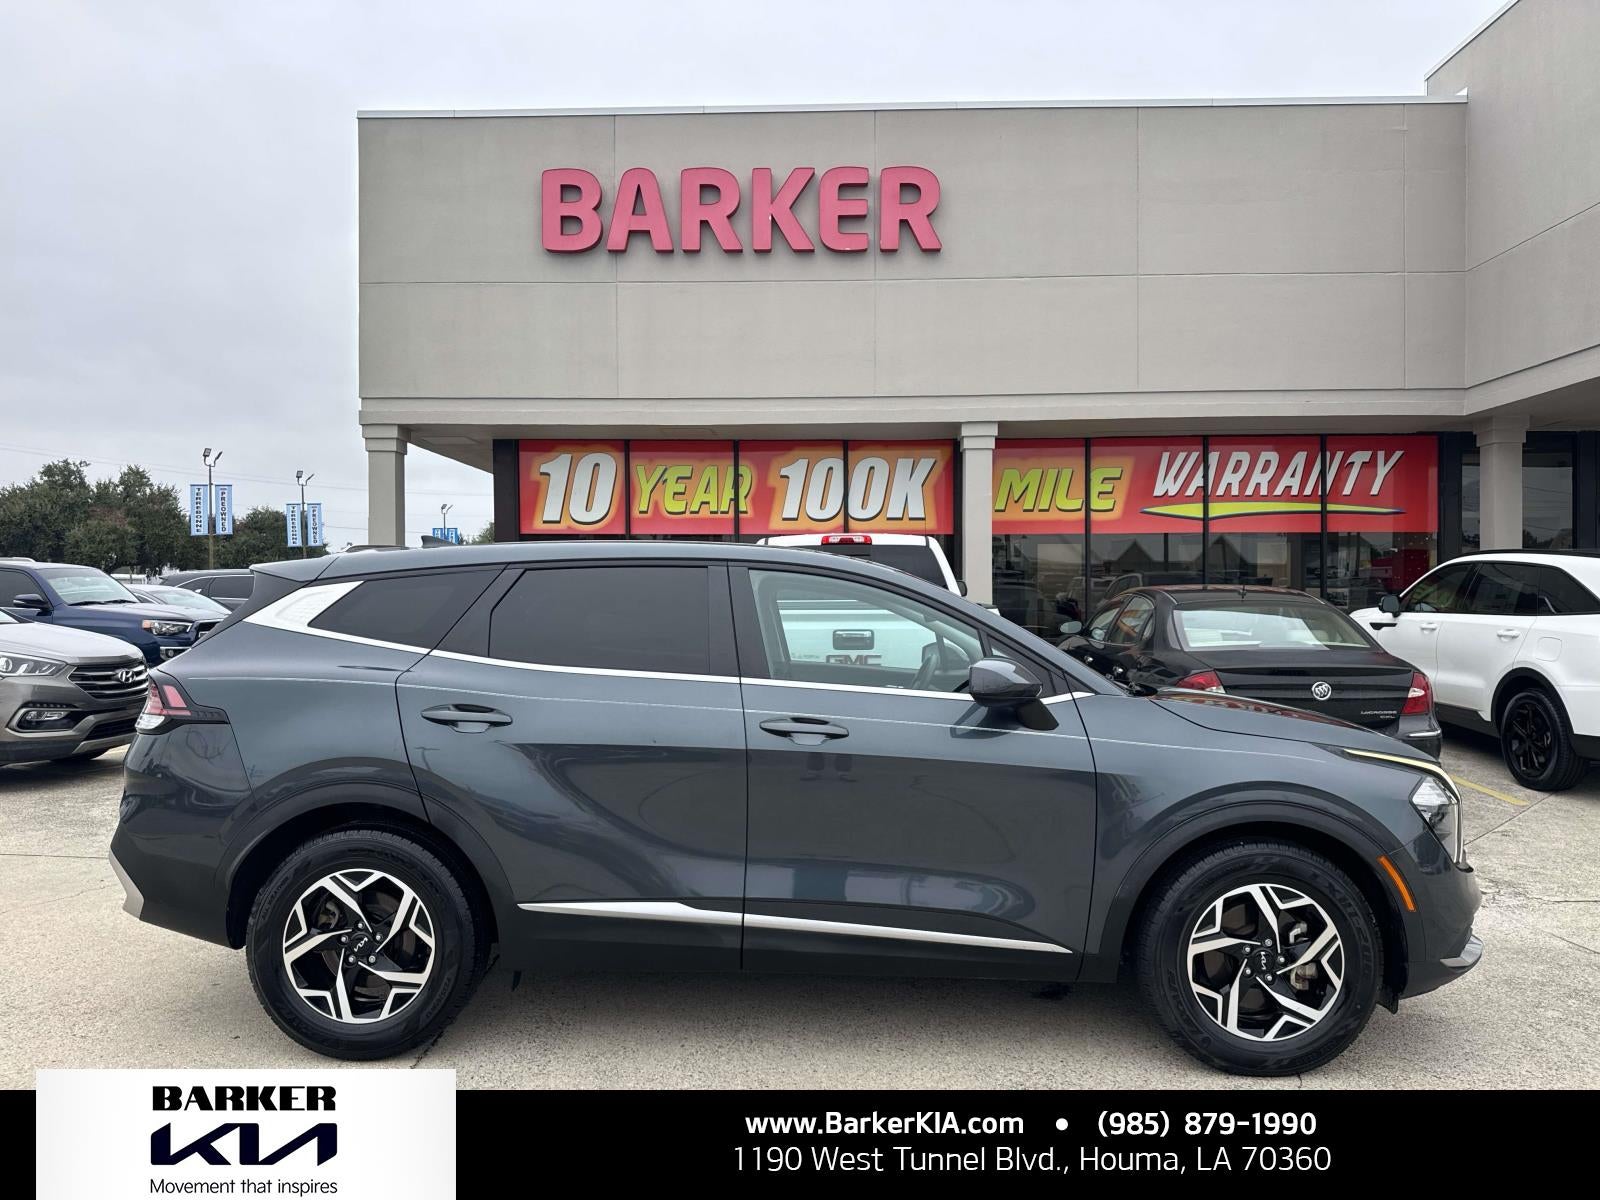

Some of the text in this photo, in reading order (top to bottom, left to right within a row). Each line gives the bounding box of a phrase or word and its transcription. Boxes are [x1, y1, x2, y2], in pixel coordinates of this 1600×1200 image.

[542, 166, 942, 252] BARKER
[195, 487, 203, 533] TERREBONNE
[539, 449, 1405, 526] 10 YEAR 100K MILE WARRANTY
[825, 654, 882, 666] GMC
